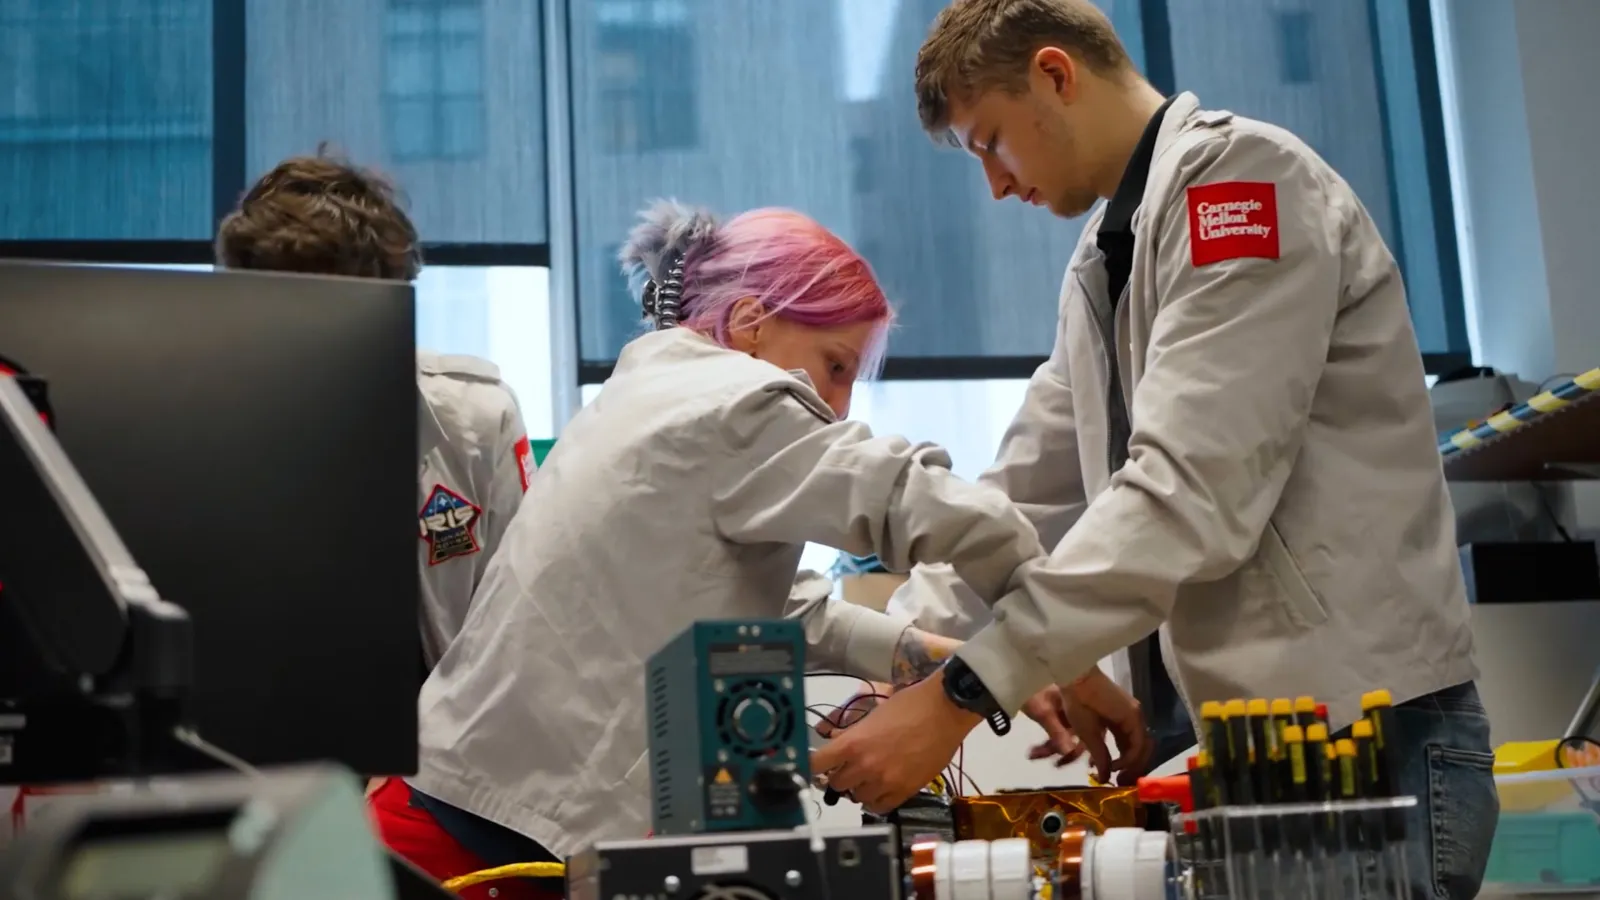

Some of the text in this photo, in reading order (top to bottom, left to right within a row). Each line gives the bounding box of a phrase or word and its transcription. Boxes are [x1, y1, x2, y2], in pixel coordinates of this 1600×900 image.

[1197, 199, 1262, 214] Carnegie
[1198, 211, 1248, 227] Mellon
[1199, 224, 1271, 240] University
